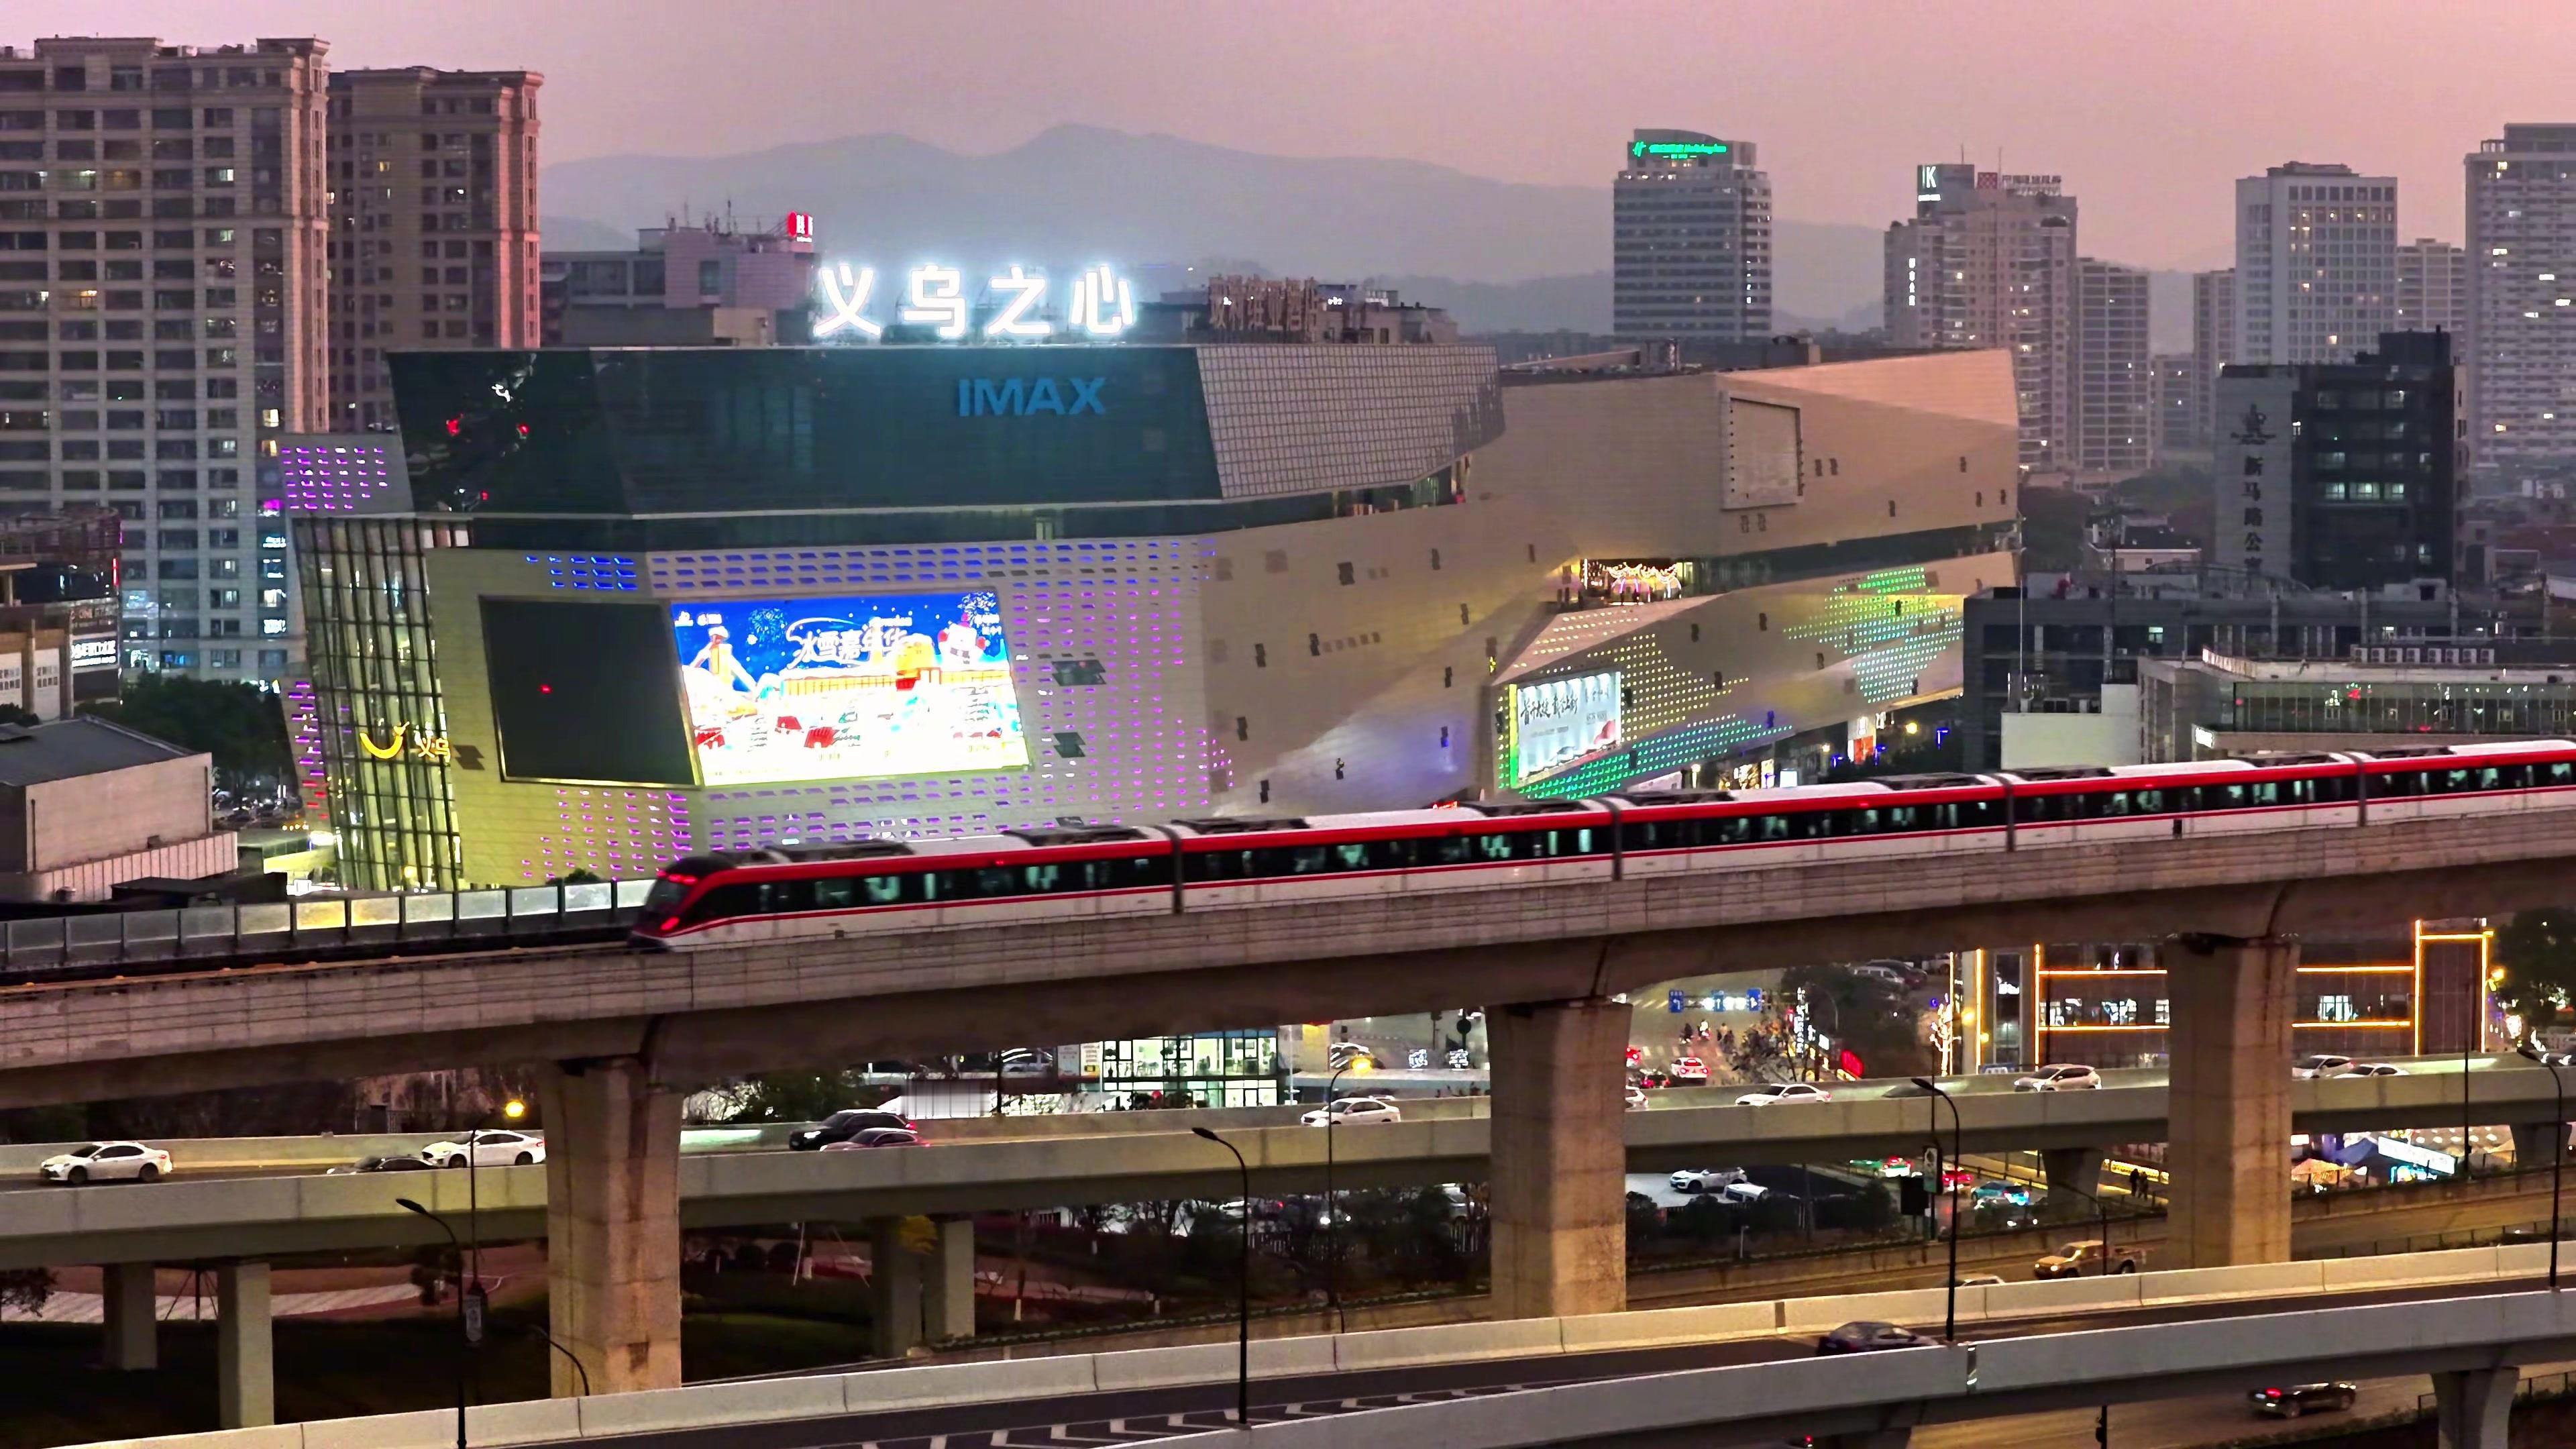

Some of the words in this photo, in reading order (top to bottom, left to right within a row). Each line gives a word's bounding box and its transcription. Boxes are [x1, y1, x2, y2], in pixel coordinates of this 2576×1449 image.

[813, 264, 1135, 338] 义乌之心
[958, 376, 1107, 417] IMAX
